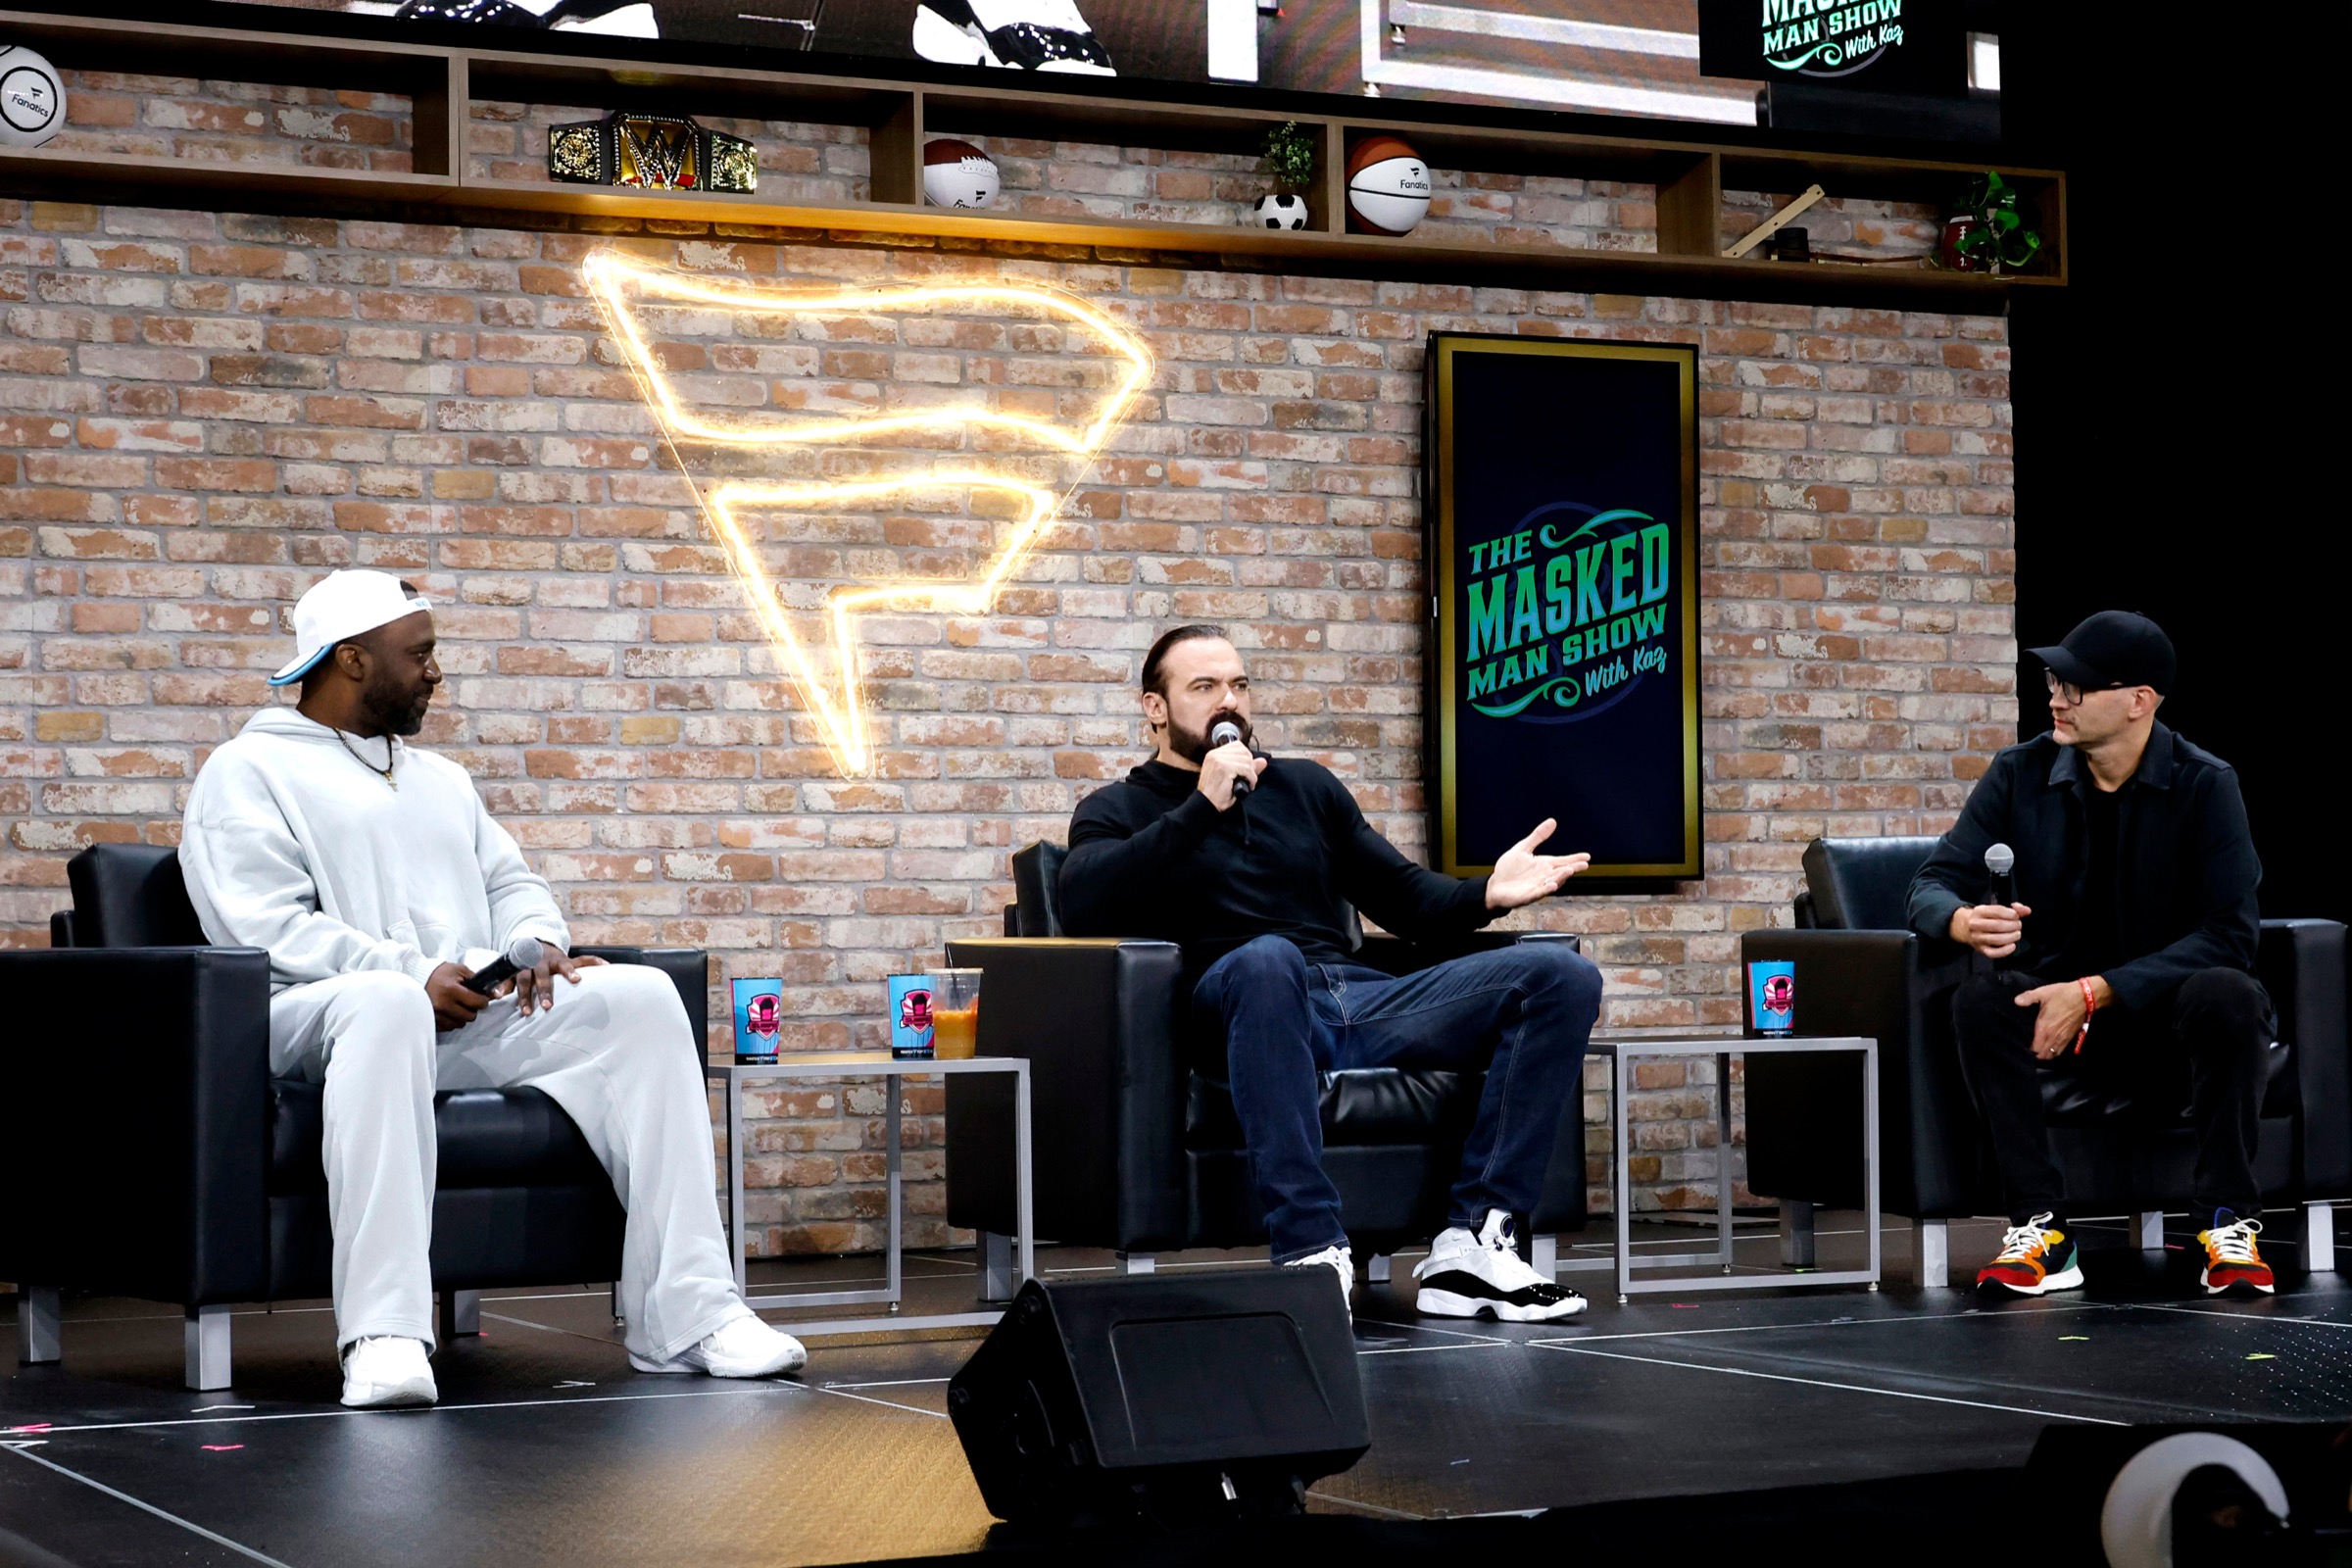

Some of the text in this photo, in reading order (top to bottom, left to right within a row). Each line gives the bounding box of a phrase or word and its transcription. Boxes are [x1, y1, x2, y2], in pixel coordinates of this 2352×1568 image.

[1762, 17, 1820, 56] MAN
[1829, 0, 1901, 36] SHOW
[1844, 24, 1904, 60] With Kaz
[12, 93, 49, 118] Fanatics
[1399, 179, 1429, 191] Fanatics
[1468, 529, 1533, 575] THE
[1466, 522, 1670, 662] MASKED
[1466, 603, 1667, 701] MAN SHOW
[1585, 646, 1667, 697] With Kaz
